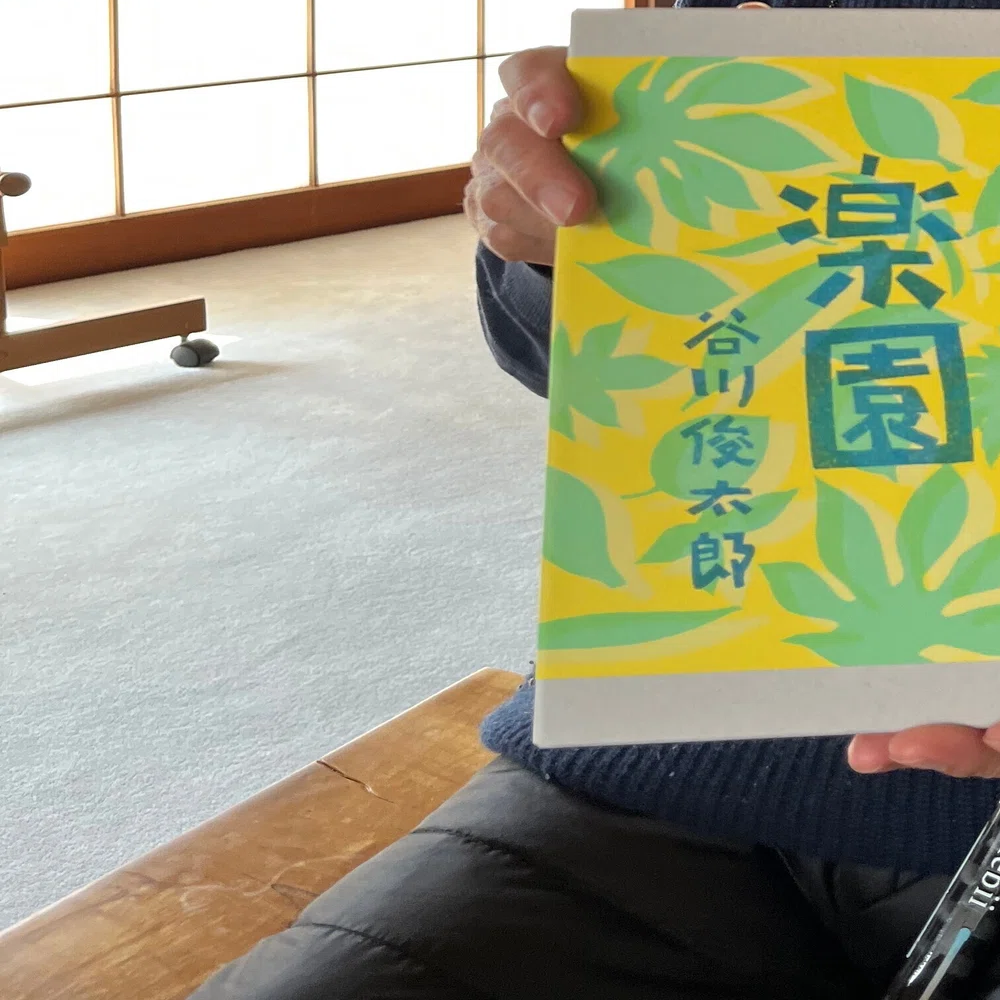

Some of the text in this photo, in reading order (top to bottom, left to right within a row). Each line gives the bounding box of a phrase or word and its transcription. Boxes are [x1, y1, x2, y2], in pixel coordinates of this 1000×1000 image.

[679, 310, 761, 591] 谷川俊太郎
[778, 154, 974, 469] 楽園
